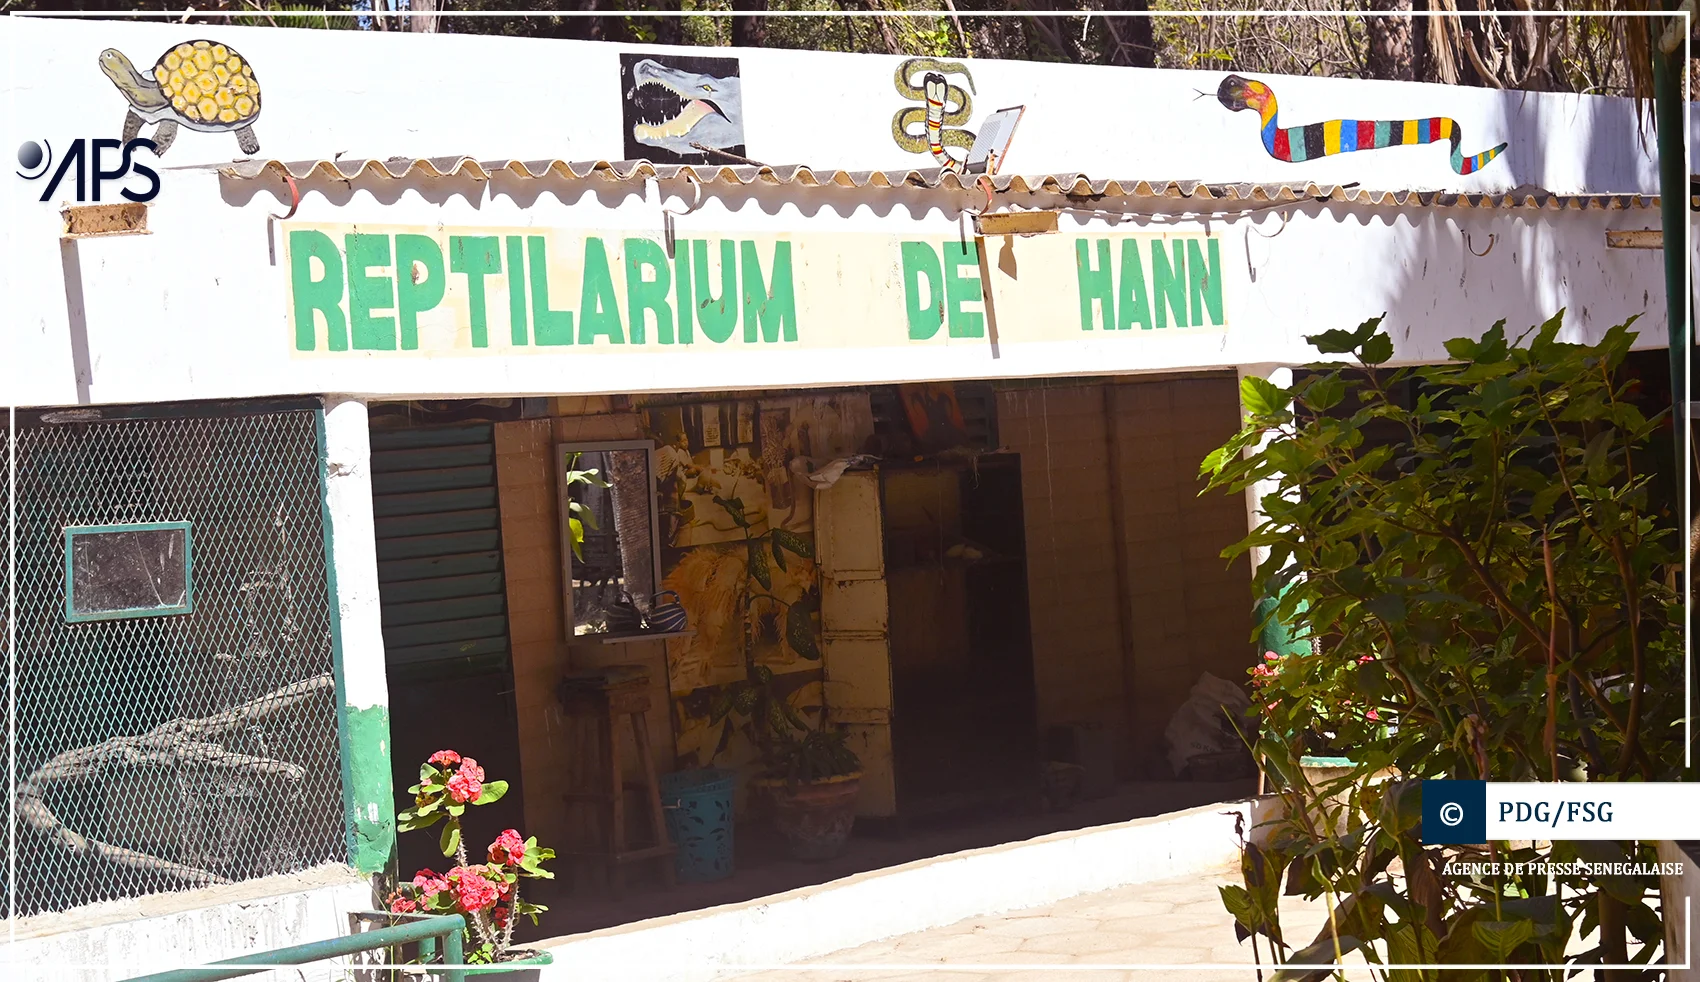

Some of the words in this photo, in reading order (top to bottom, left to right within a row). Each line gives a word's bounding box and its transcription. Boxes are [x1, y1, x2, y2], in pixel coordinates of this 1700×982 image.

[290, 230, 798, 351] REPTILARIUM
[901, 240, 984, 340] DE
[1075, 237, 1224, 331] HANN
